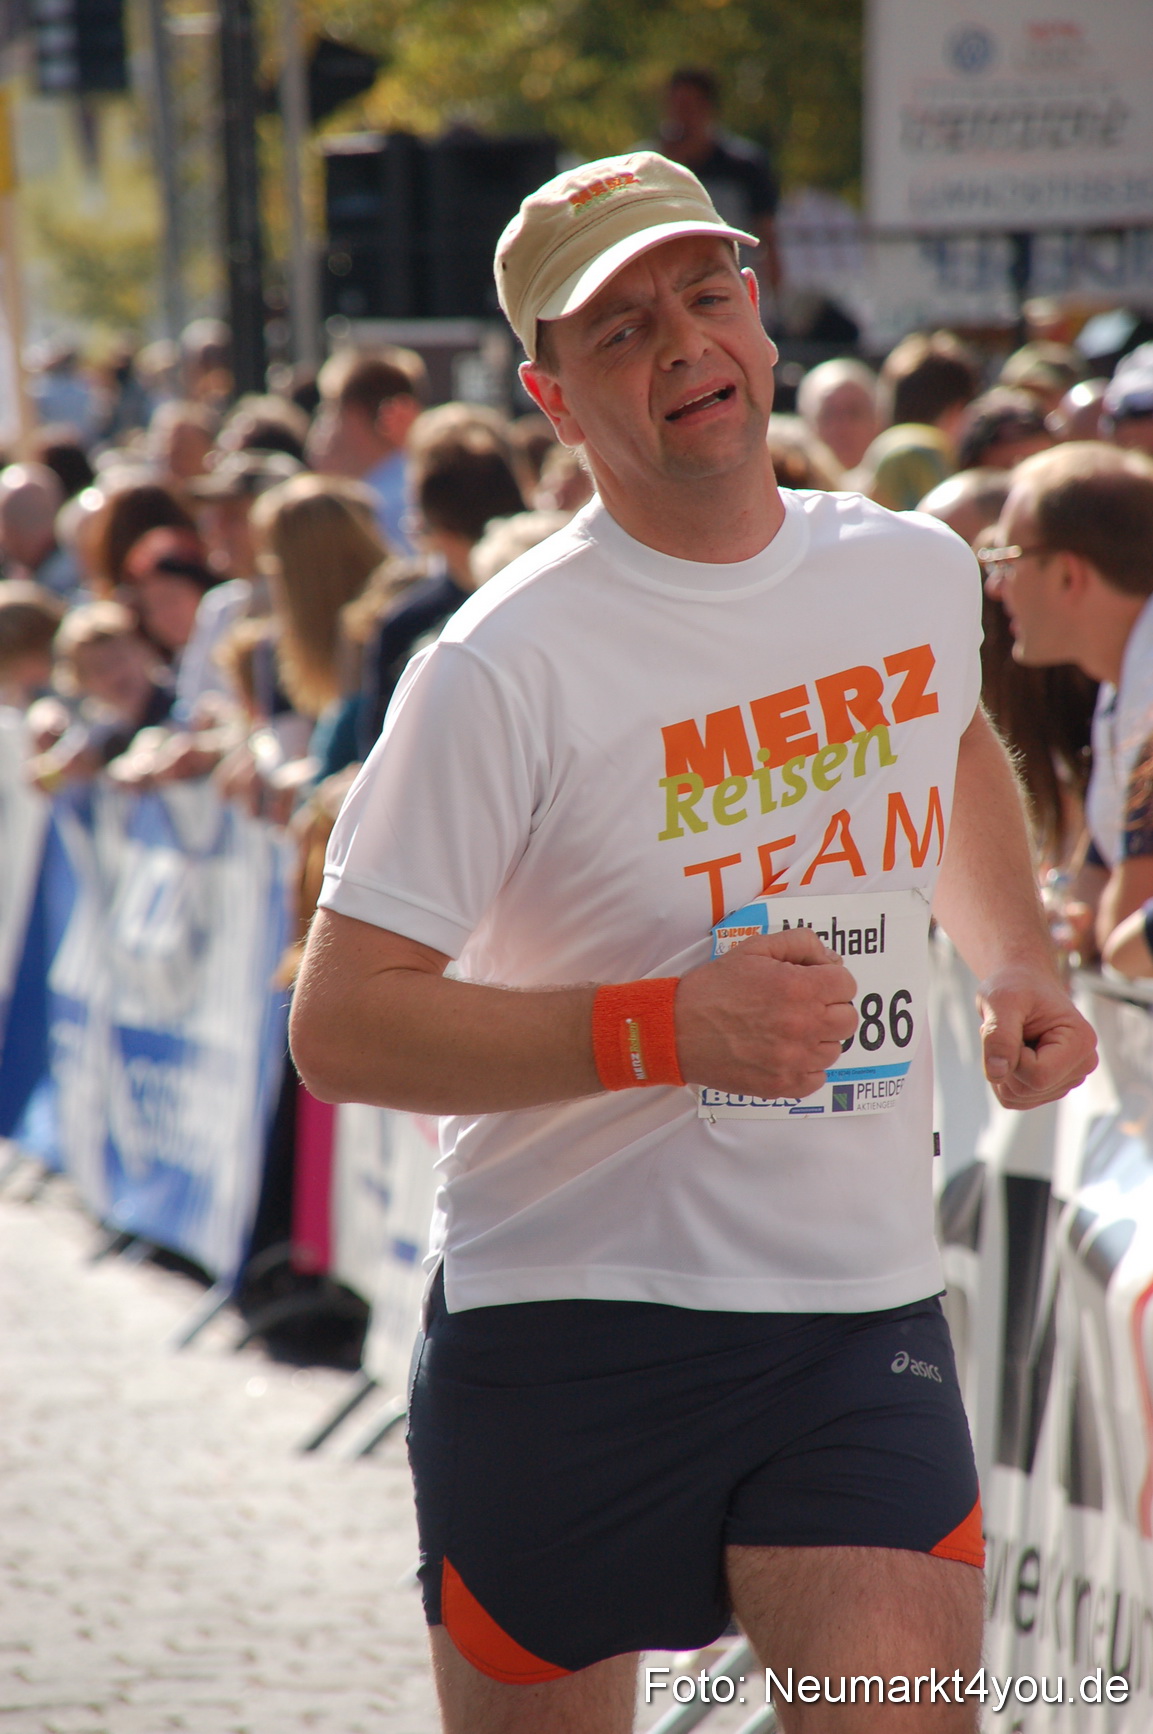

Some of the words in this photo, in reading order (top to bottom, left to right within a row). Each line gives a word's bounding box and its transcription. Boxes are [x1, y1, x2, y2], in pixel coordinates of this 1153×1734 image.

[661, 643, 939, 796] MERZ
[658, 723, 898, 842] Reisen
[683, 786, 945, 928] TEAM
[840, 989, 914, 1054] 86
[910, 1359, 943, 1383] asics
